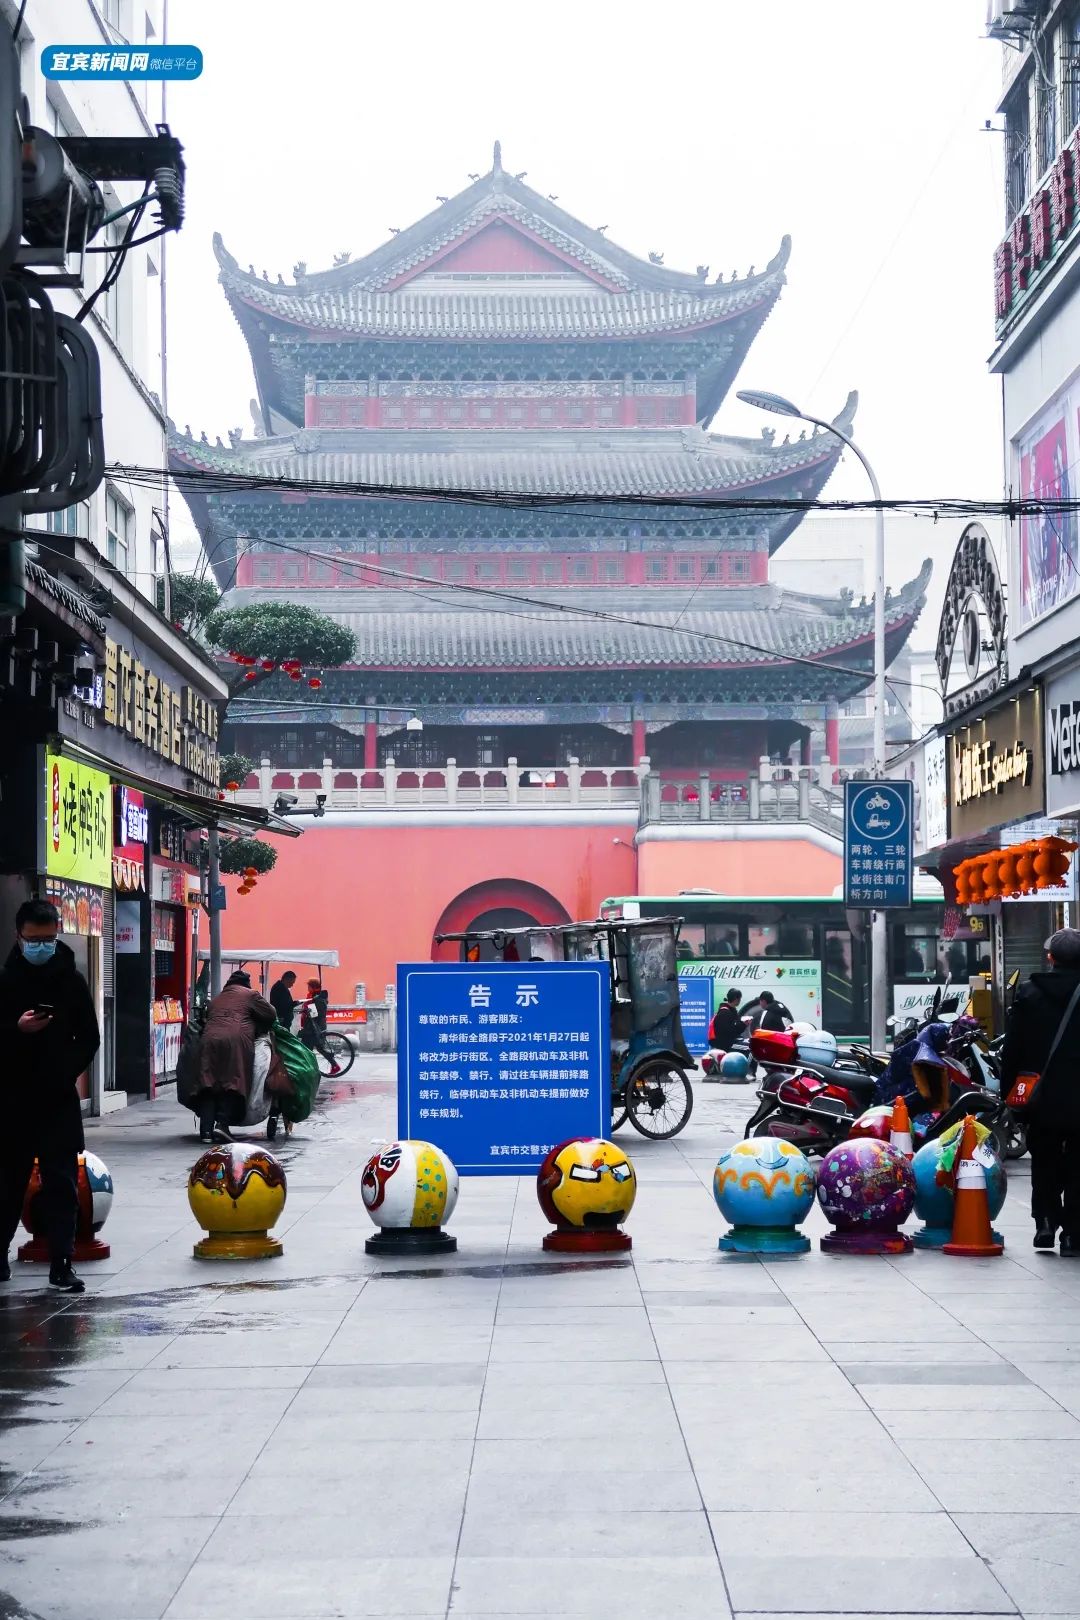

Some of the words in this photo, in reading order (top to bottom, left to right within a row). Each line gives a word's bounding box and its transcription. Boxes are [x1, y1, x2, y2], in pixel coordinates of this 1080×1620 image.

[851, 844, 906, 855] 两轮、三轮
[851, 859, 906, 870] 车请绕行商
[851, 874, 905, 885] 业街往南门
[438, 1032, 590, 1043] 清华街全路段于2021年1月27日起
[419, 1051, 589, 1062] 将改为步行街区。全路段机动车及非机
[419, 1070, 589, 1081] 动车禁停、禁行。请过往车辆提前择路
[419, 1089, 590, 1100] 绕行，临停机动车及非机动车提前做好
[419, 1108, 464, 1118] 停车规划。
